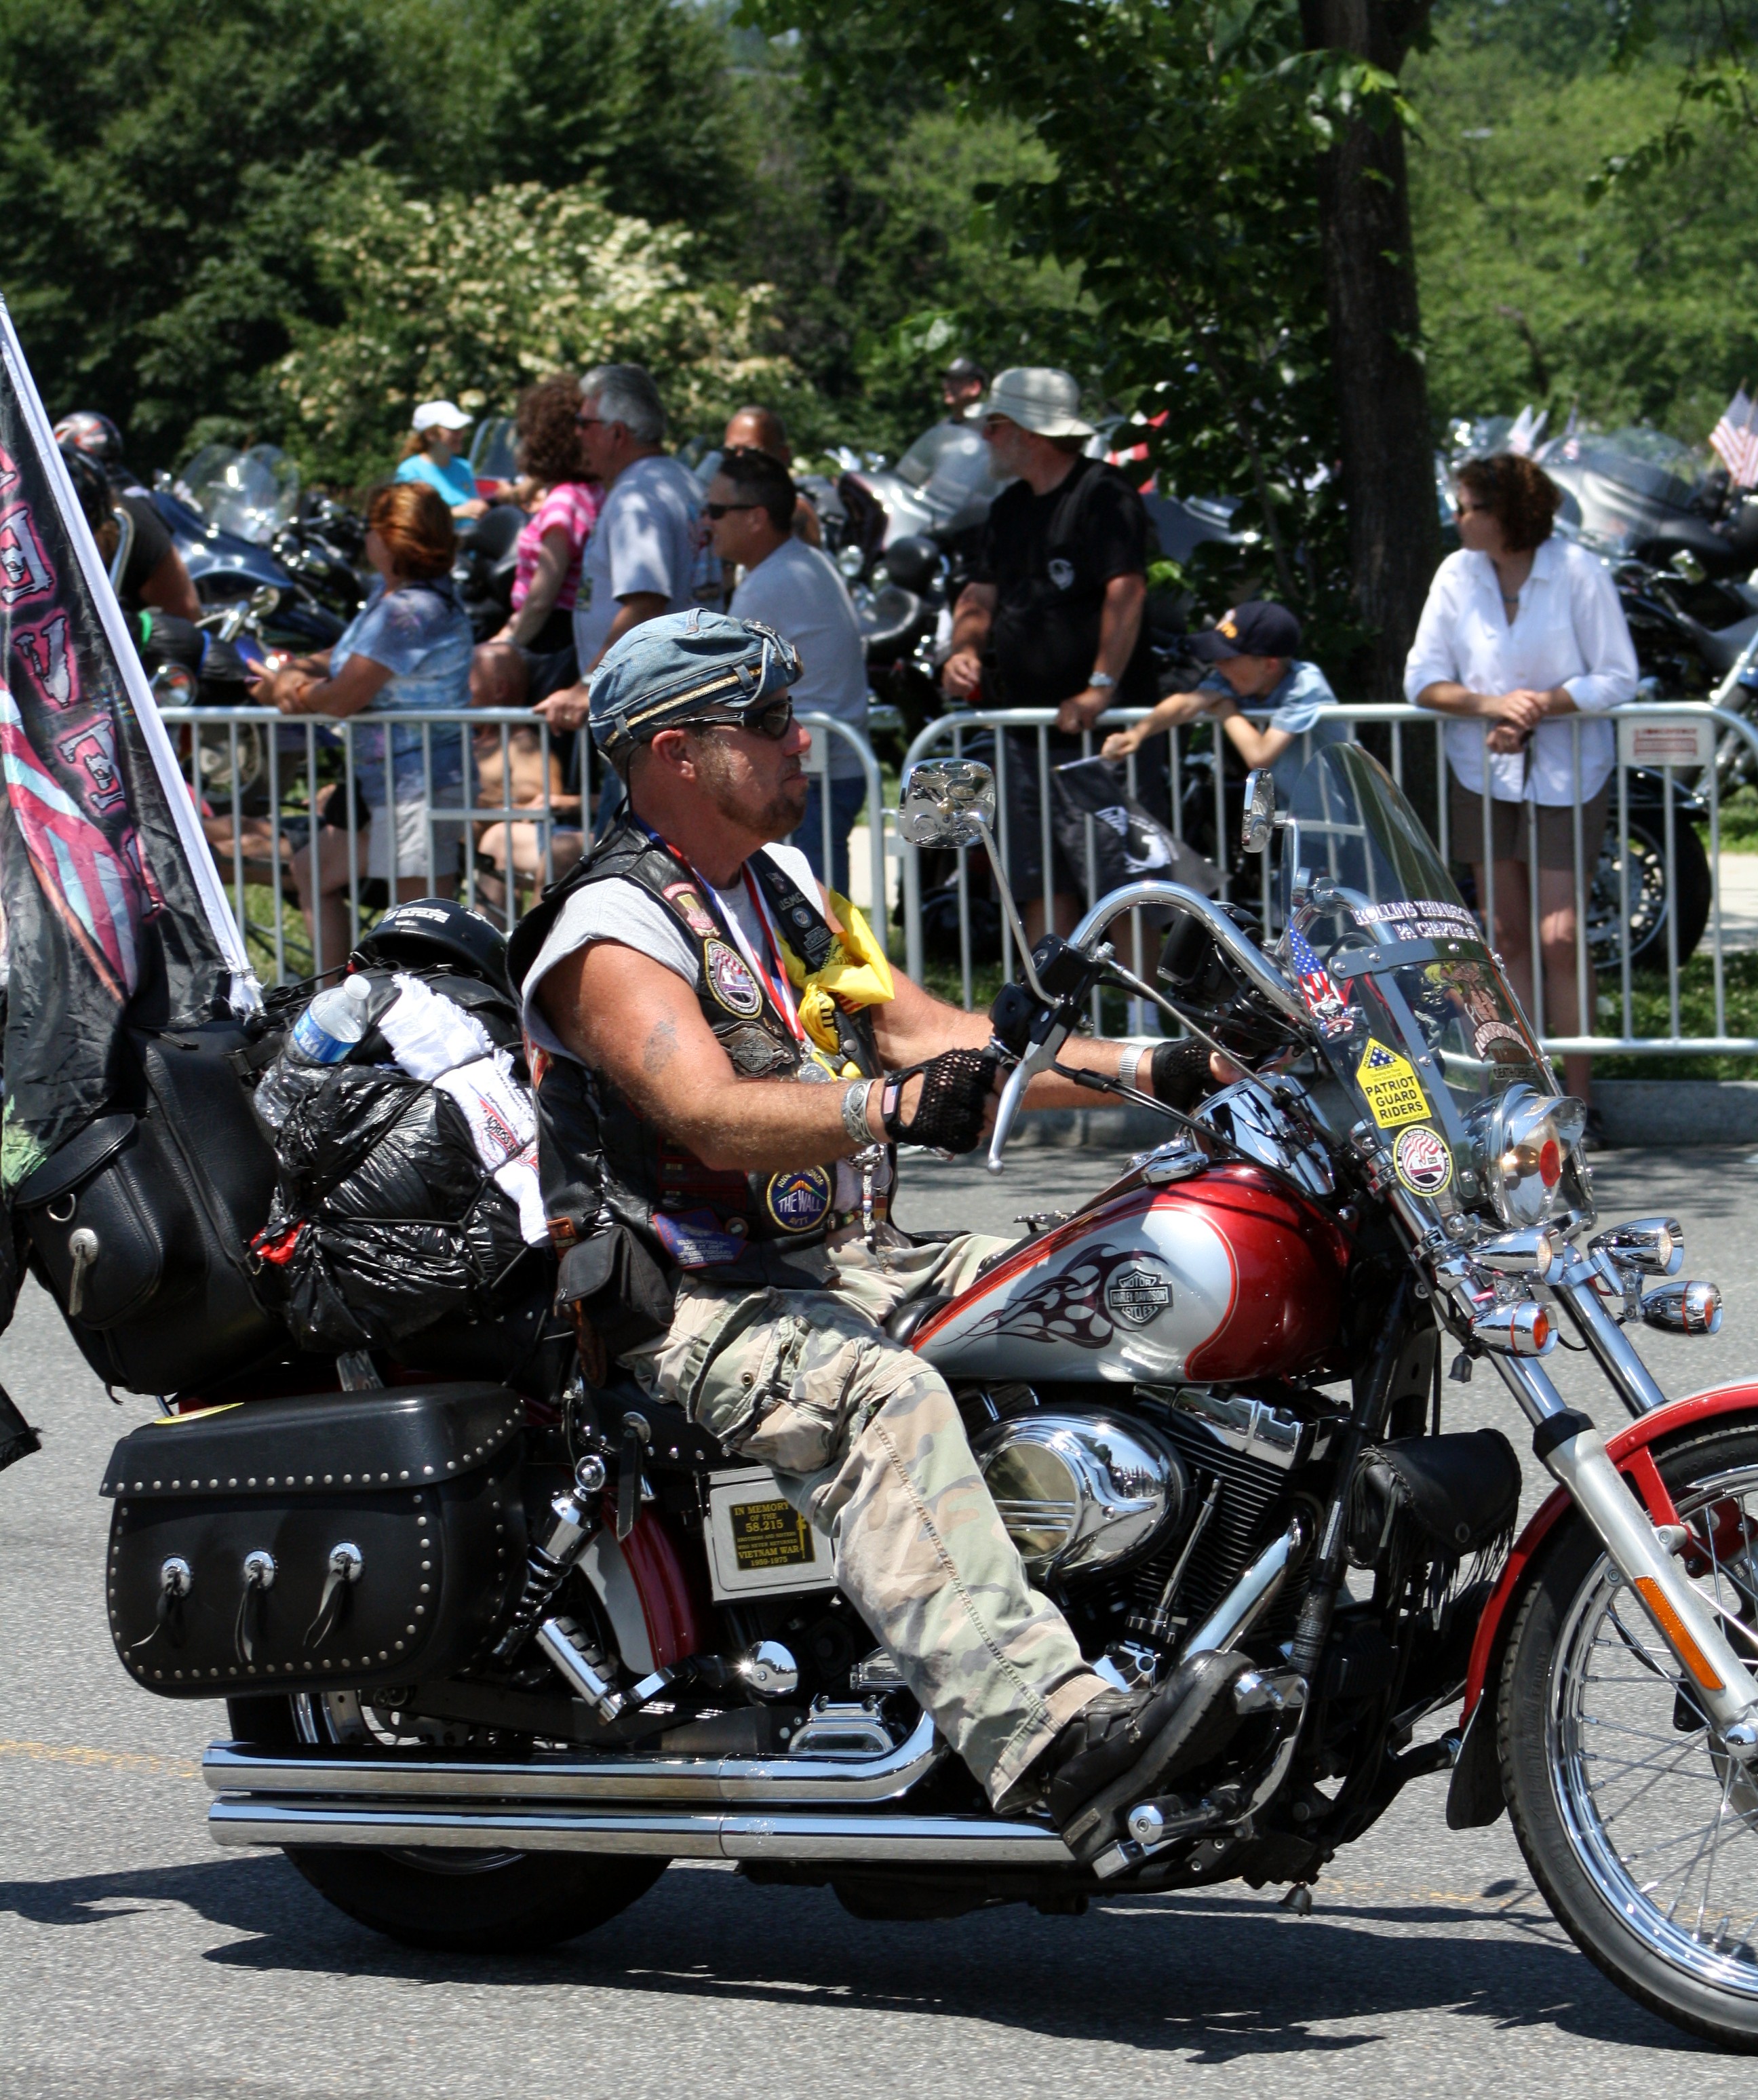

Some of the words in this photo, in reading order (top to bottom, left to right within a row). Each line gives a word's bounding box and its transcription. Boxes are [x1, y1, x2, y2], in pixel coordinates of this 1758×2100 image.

[1350, 901, 1418, 926] ROLLING
[1392, 922, 1418, 941] PA
[1363, 1045, 1373, 1067] PATRIOT
[1365, 1076, 1415, 1097] PATRIOT
[1375, 1089, 1417, 1107] GUARD
[1379, 1101, 1424, 1120] RIDERS
[778, 1192, 798, 1213] THE
[798, 1189, 821, 1212] WALL
[1121, 1275, 1152, 1287] MOTOR
[1112, 1289, 1167, 1303] HARLEY-DAVIDSON
[1125, 1305, 1154, 1320] CYCLES
[734, 1506, 745, 1515] IN
[747, 1502, 789, 1514] MEMORY
[738, 1547, 778, 1559] VIETNAM
[779, 1545, 800, 1554] WAR
[751, 1556, 788, 1566] 1959-1975
